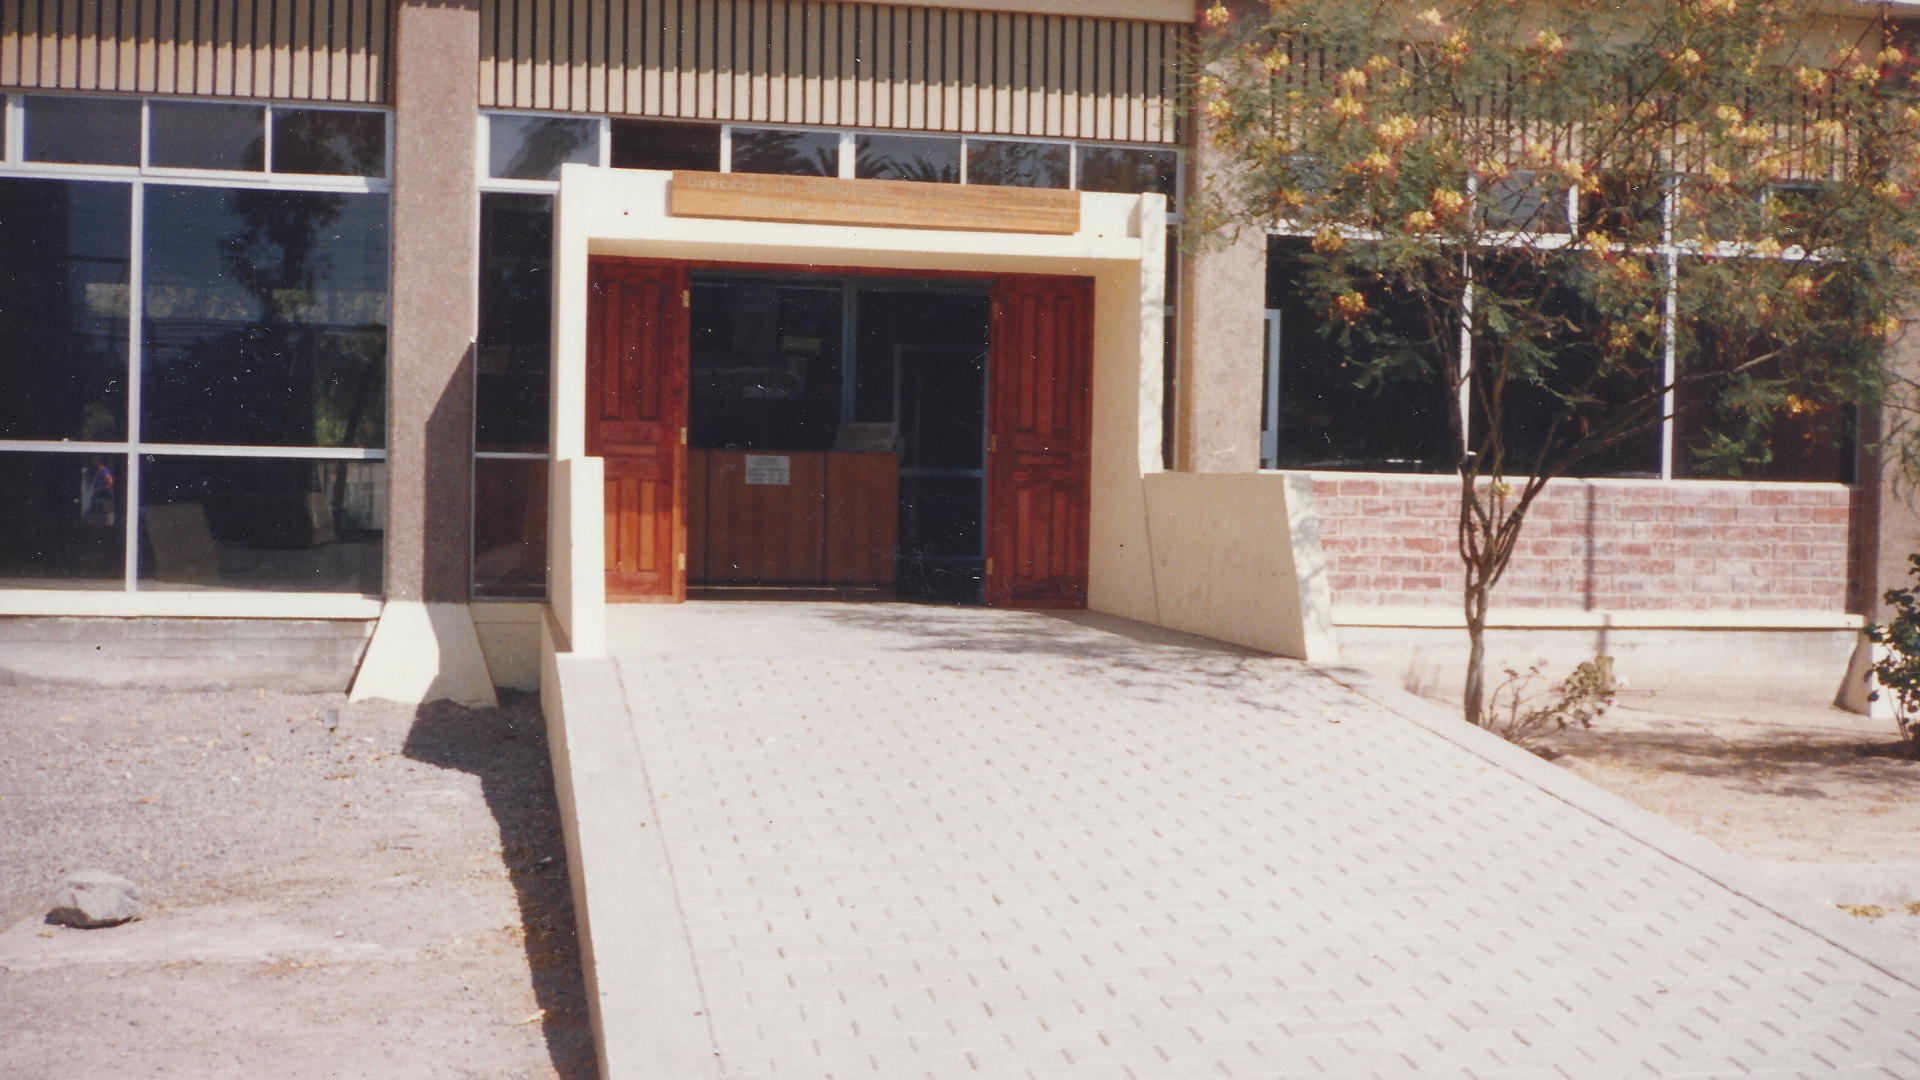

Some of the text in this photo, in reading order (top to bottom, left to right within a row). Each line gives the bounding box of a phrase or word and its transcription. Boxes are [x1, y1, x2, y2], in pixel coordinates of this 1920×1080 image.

[687, 175, 764, 192] Dirección
[775, 181, 795, 194] de
[807, 182, 895, 199] Bibliotecas
[741, 197, 823, 214] Biblioteca
[835, 202, 903, 218] Regional
